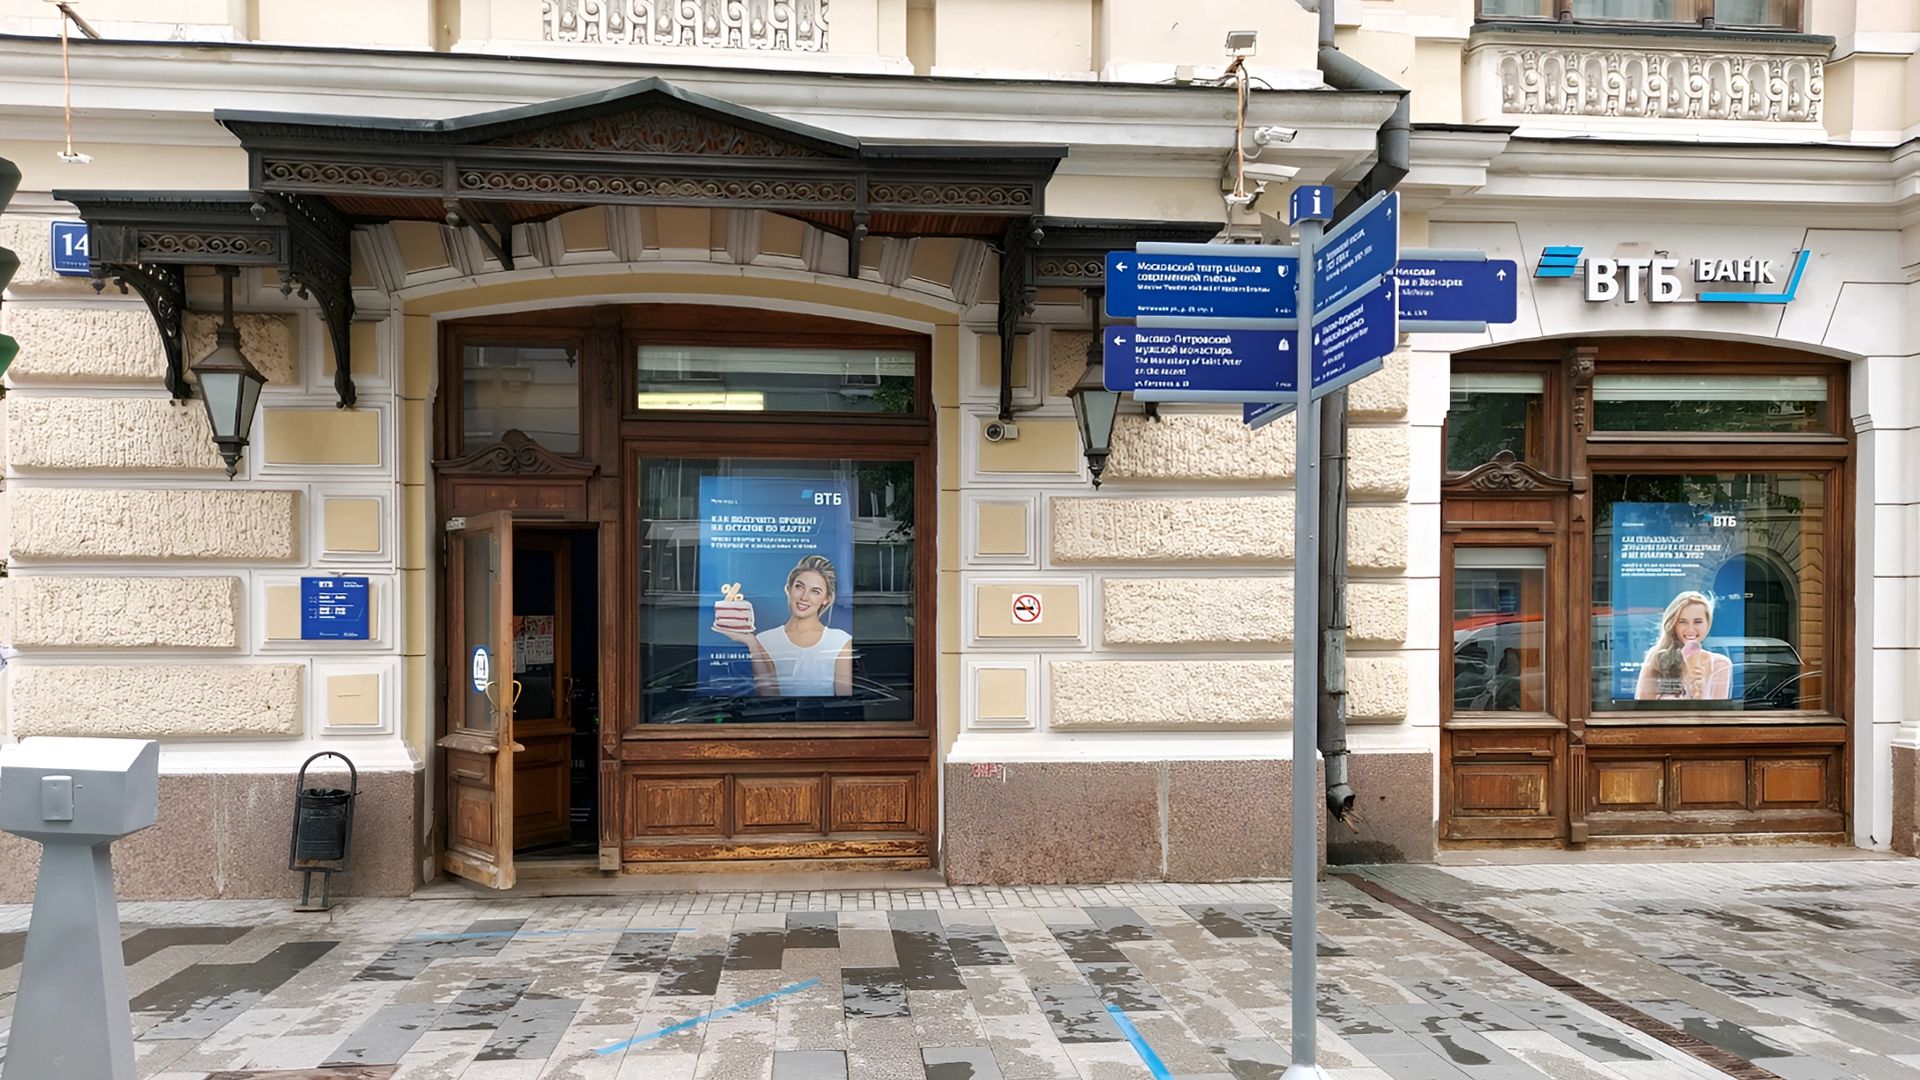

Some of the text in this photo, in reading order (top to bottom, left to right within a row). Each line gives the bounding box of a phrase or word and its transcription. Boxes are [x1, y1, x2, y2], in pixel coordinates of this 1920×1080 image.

[62, 233, 89, 256] 14
[1137, 262, 1195, 272] Московский
[1584, 258, 1776, 303] ВТБ БАНК
[1135, 334, 1231, 345] Высоко-Петровский
[1180, 346, 1233, 356] монастырь
[814, 492, 842, 505] ВТБ
[1713, 516, 1737, 527] ВТБ
